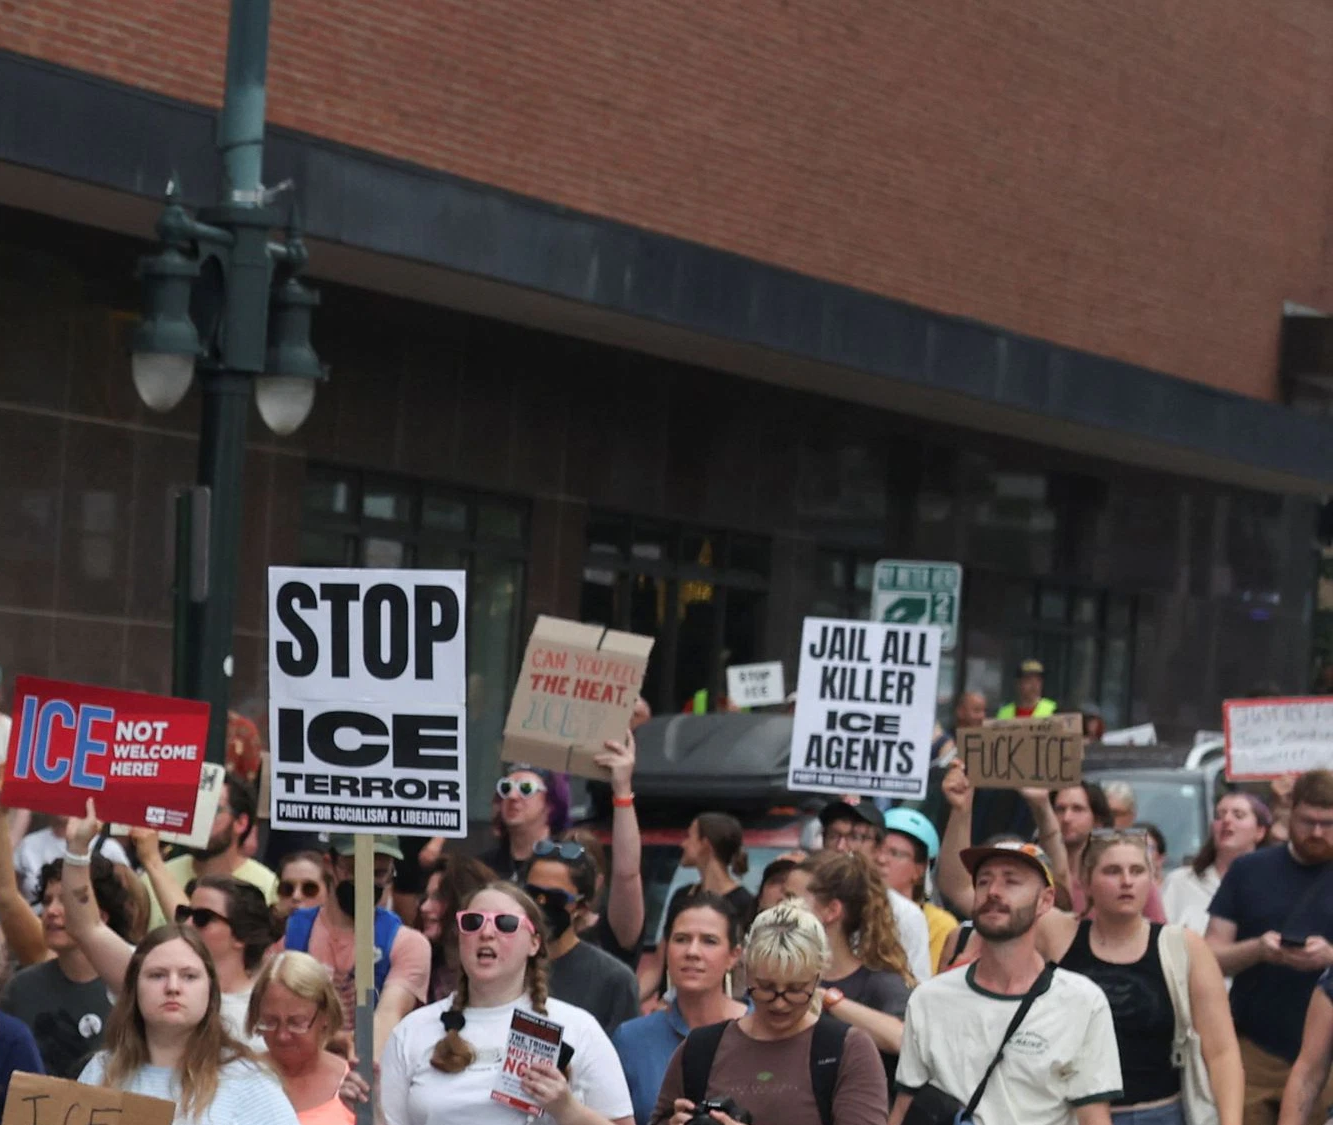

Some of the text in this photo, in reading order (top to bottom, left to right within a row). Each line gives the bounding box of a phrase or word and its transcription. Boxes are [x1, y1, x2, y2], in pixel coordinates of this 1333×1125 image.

[276, 581, 459, 681] STOP
[809, 626, 931, 667] JAIL ALL
[531, 650, 568, 669] CAN
[530, 674, 571, 696] THE
[820, 666, 915, 705] KILLER
[115, 720, 169, 742] NOT
[826, 711, 901, 735] ICE
[14, 694, 115, 791] ICE
[278, 708, 459, 770] ICE
[113, 744, 198, 760] WELCOME
[804, 734, 915, 774] AGENTS
[964, 733, 1074, 781] FUCK ICE
[110, 762, 159, 776] HERE!
[277, 771, 460, 802] TERROR
[279, 803, 312, 821] PARTY
[314, 805, 331, 822] FOR
[333, 806, 388, 825] SOCIALISM
[400, 808, 458, 828] LIBERATION
[508, 1046, 535, 1063] MUST
[529, 1038, 557, 1054] TRUMP
